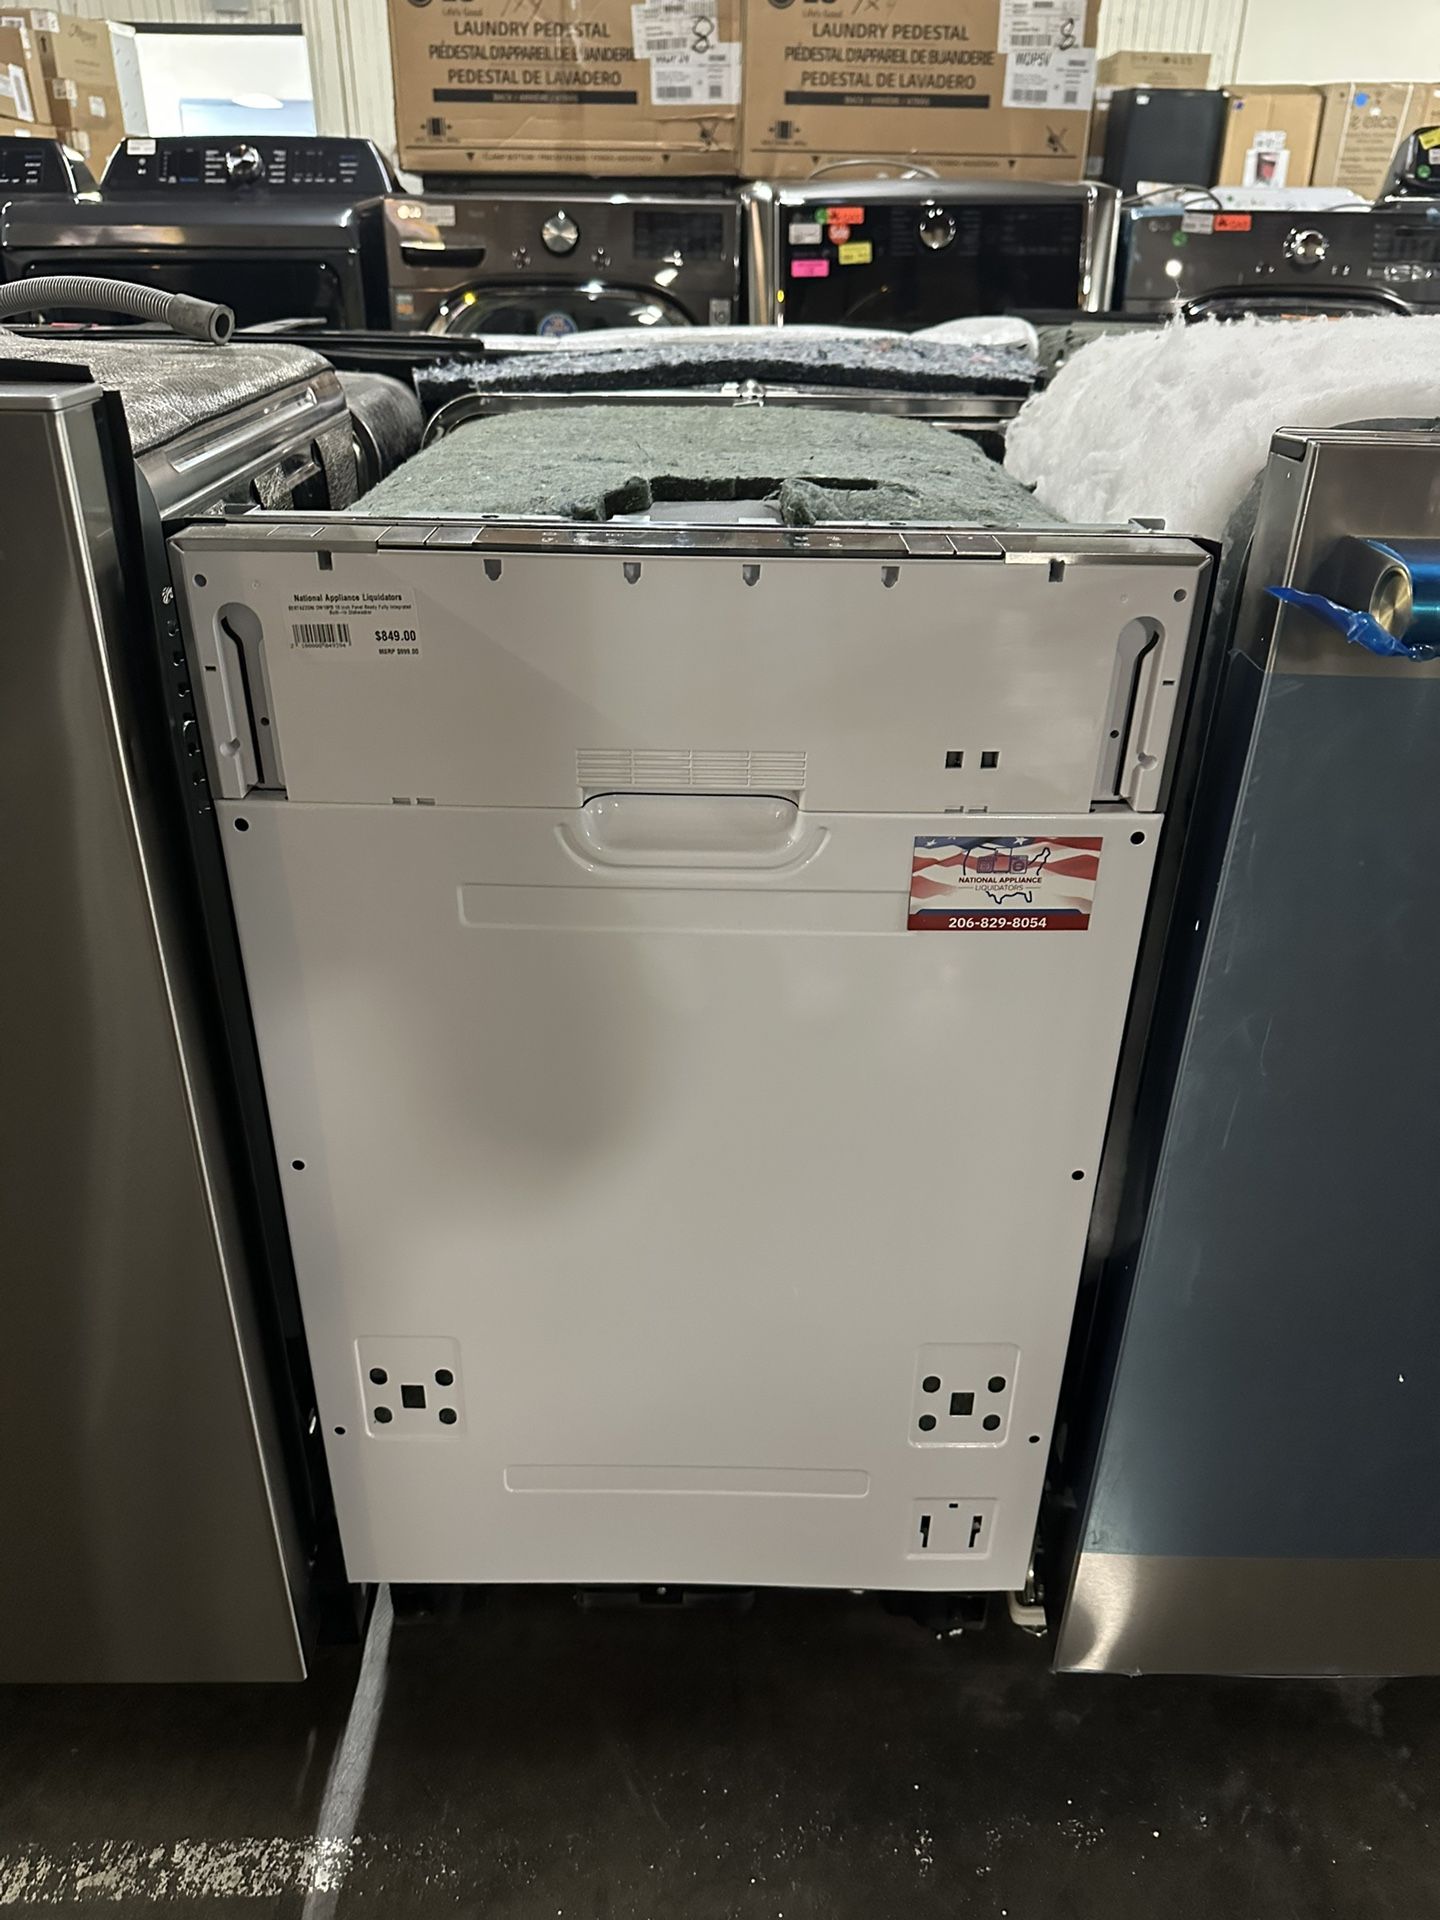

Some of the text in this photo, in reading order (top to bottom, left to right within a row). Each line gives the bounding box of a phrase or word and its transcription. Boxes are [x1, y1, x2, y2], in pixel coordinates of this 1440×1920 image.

[453, 21, 529, 37] LAUNDRY
[691, 16, 715, 54] 8
[812, 22, 970, 41] LAUNDRY PEDESTAL
[1059, 18, 1077, 51] 8
[910, 48, 927, 65] DE
[928, 49, 995, 66] BUANDERIE
[447, 68, 622, 88] PEDESTAL DE LAVADERO
[801, 70, 977, 90] PEDESTAL DE LAVADERO
[293, 592, 403, 604] National Appliance Liquidators
[374, 629, 417, 642] $849.00
[958, 876, 1043, 884] NATIONAL APPLIANCE
[974, 884, 1024, 892] LIQUIDATORS
[948, 917, 1048, 929] 206-829-8054
